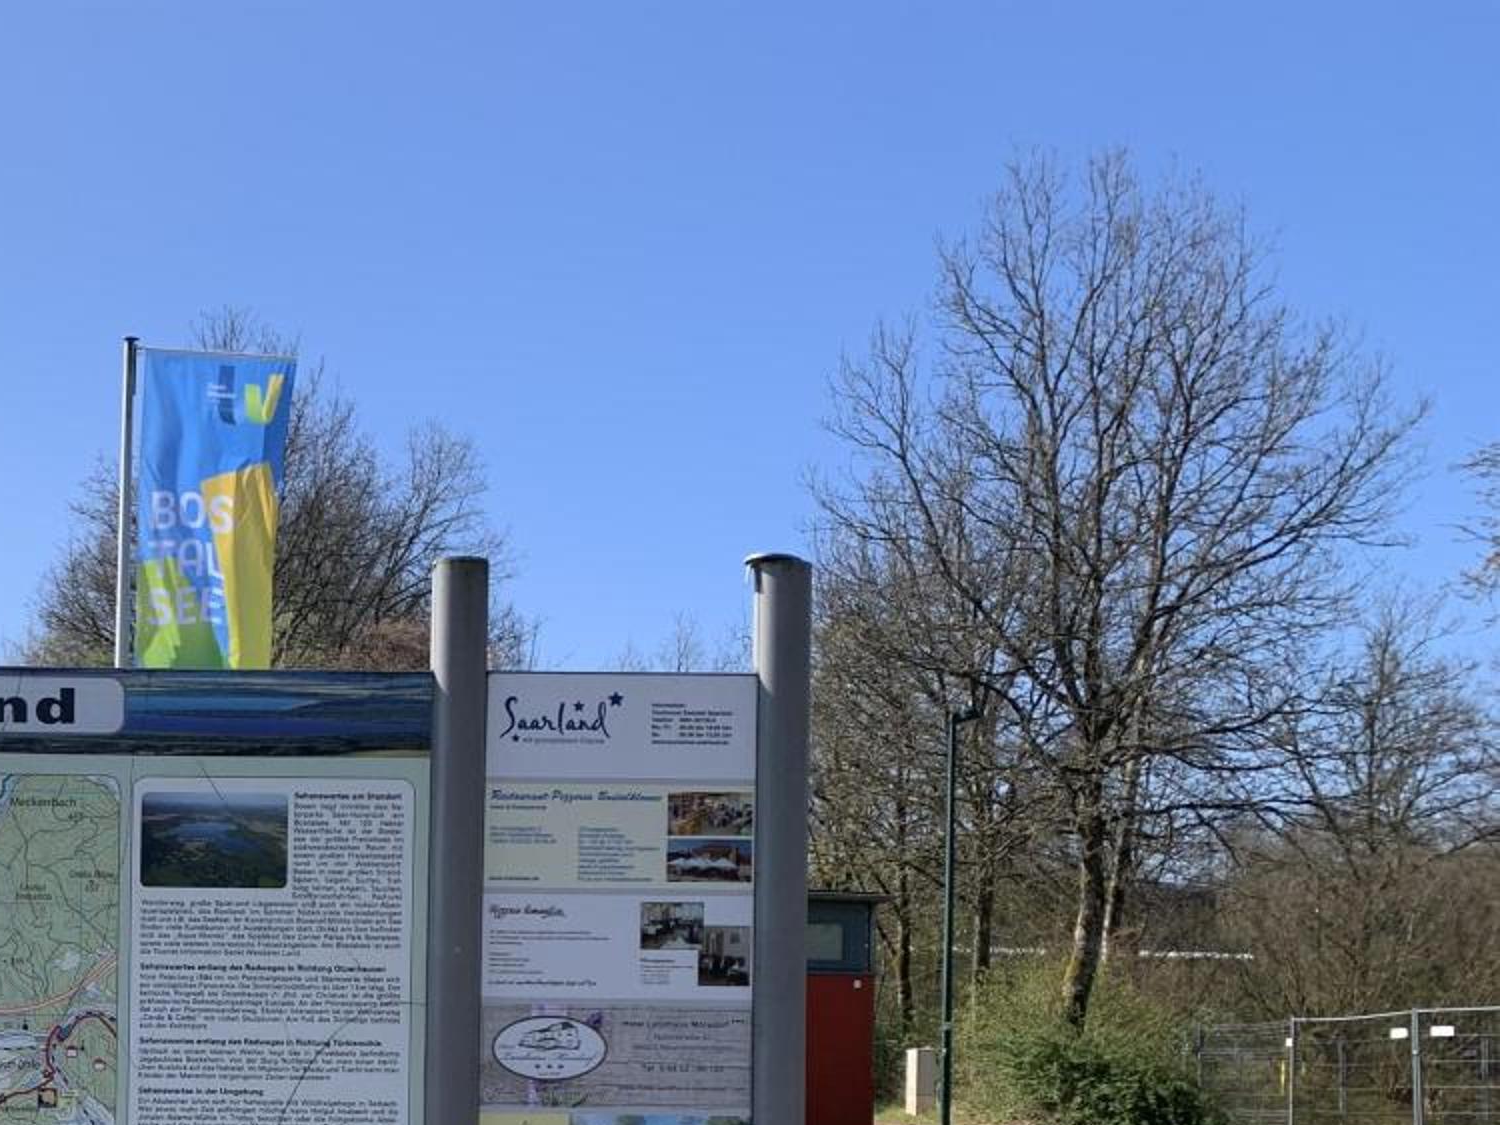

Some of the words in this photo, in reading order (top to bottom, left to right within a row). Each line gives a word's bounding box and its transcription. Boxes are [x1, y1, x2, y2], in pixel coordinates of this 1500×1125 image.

[151, 490, 234, 534] BOS
[148, 539, 223, 579] TAL
[148, 586, 224, 626] SEE
[500, 695, 611, 739] Saarland
